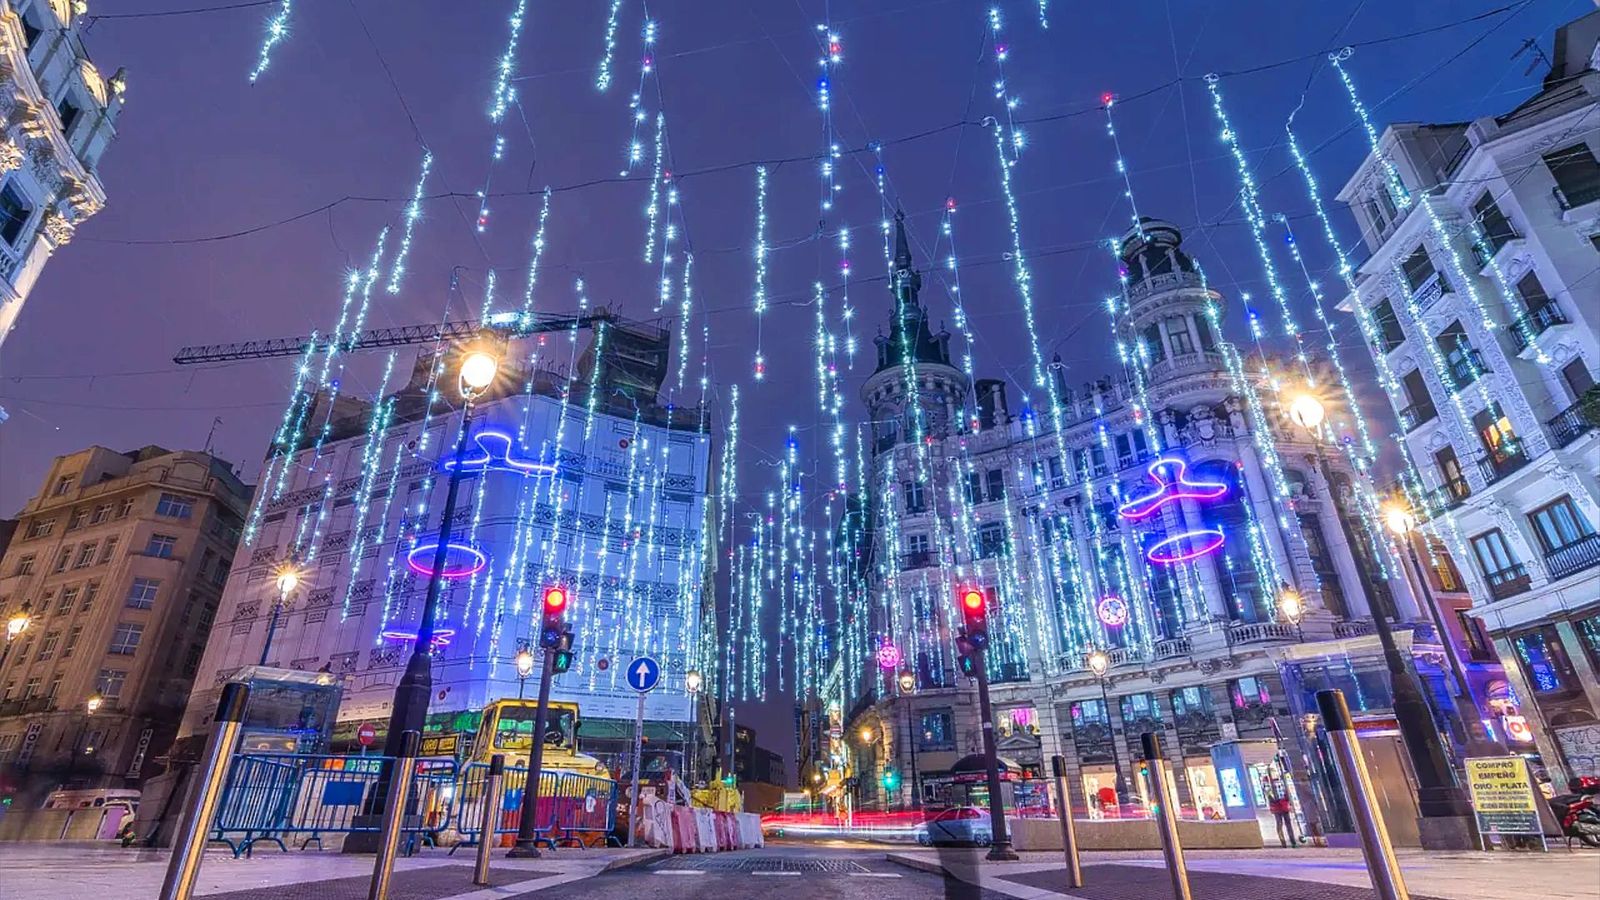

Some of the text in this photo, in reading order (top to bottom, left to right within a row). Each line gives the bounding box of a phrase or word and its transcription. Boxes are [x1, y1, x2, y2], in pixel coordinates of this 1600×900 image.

[18, 724, 41, 767] HOTE
[132, 729, 151, 771] HOTEL
[1476, 761, 1513, 769] COMPRO
[1478, 771, 1516, 779] EMPEÑO
